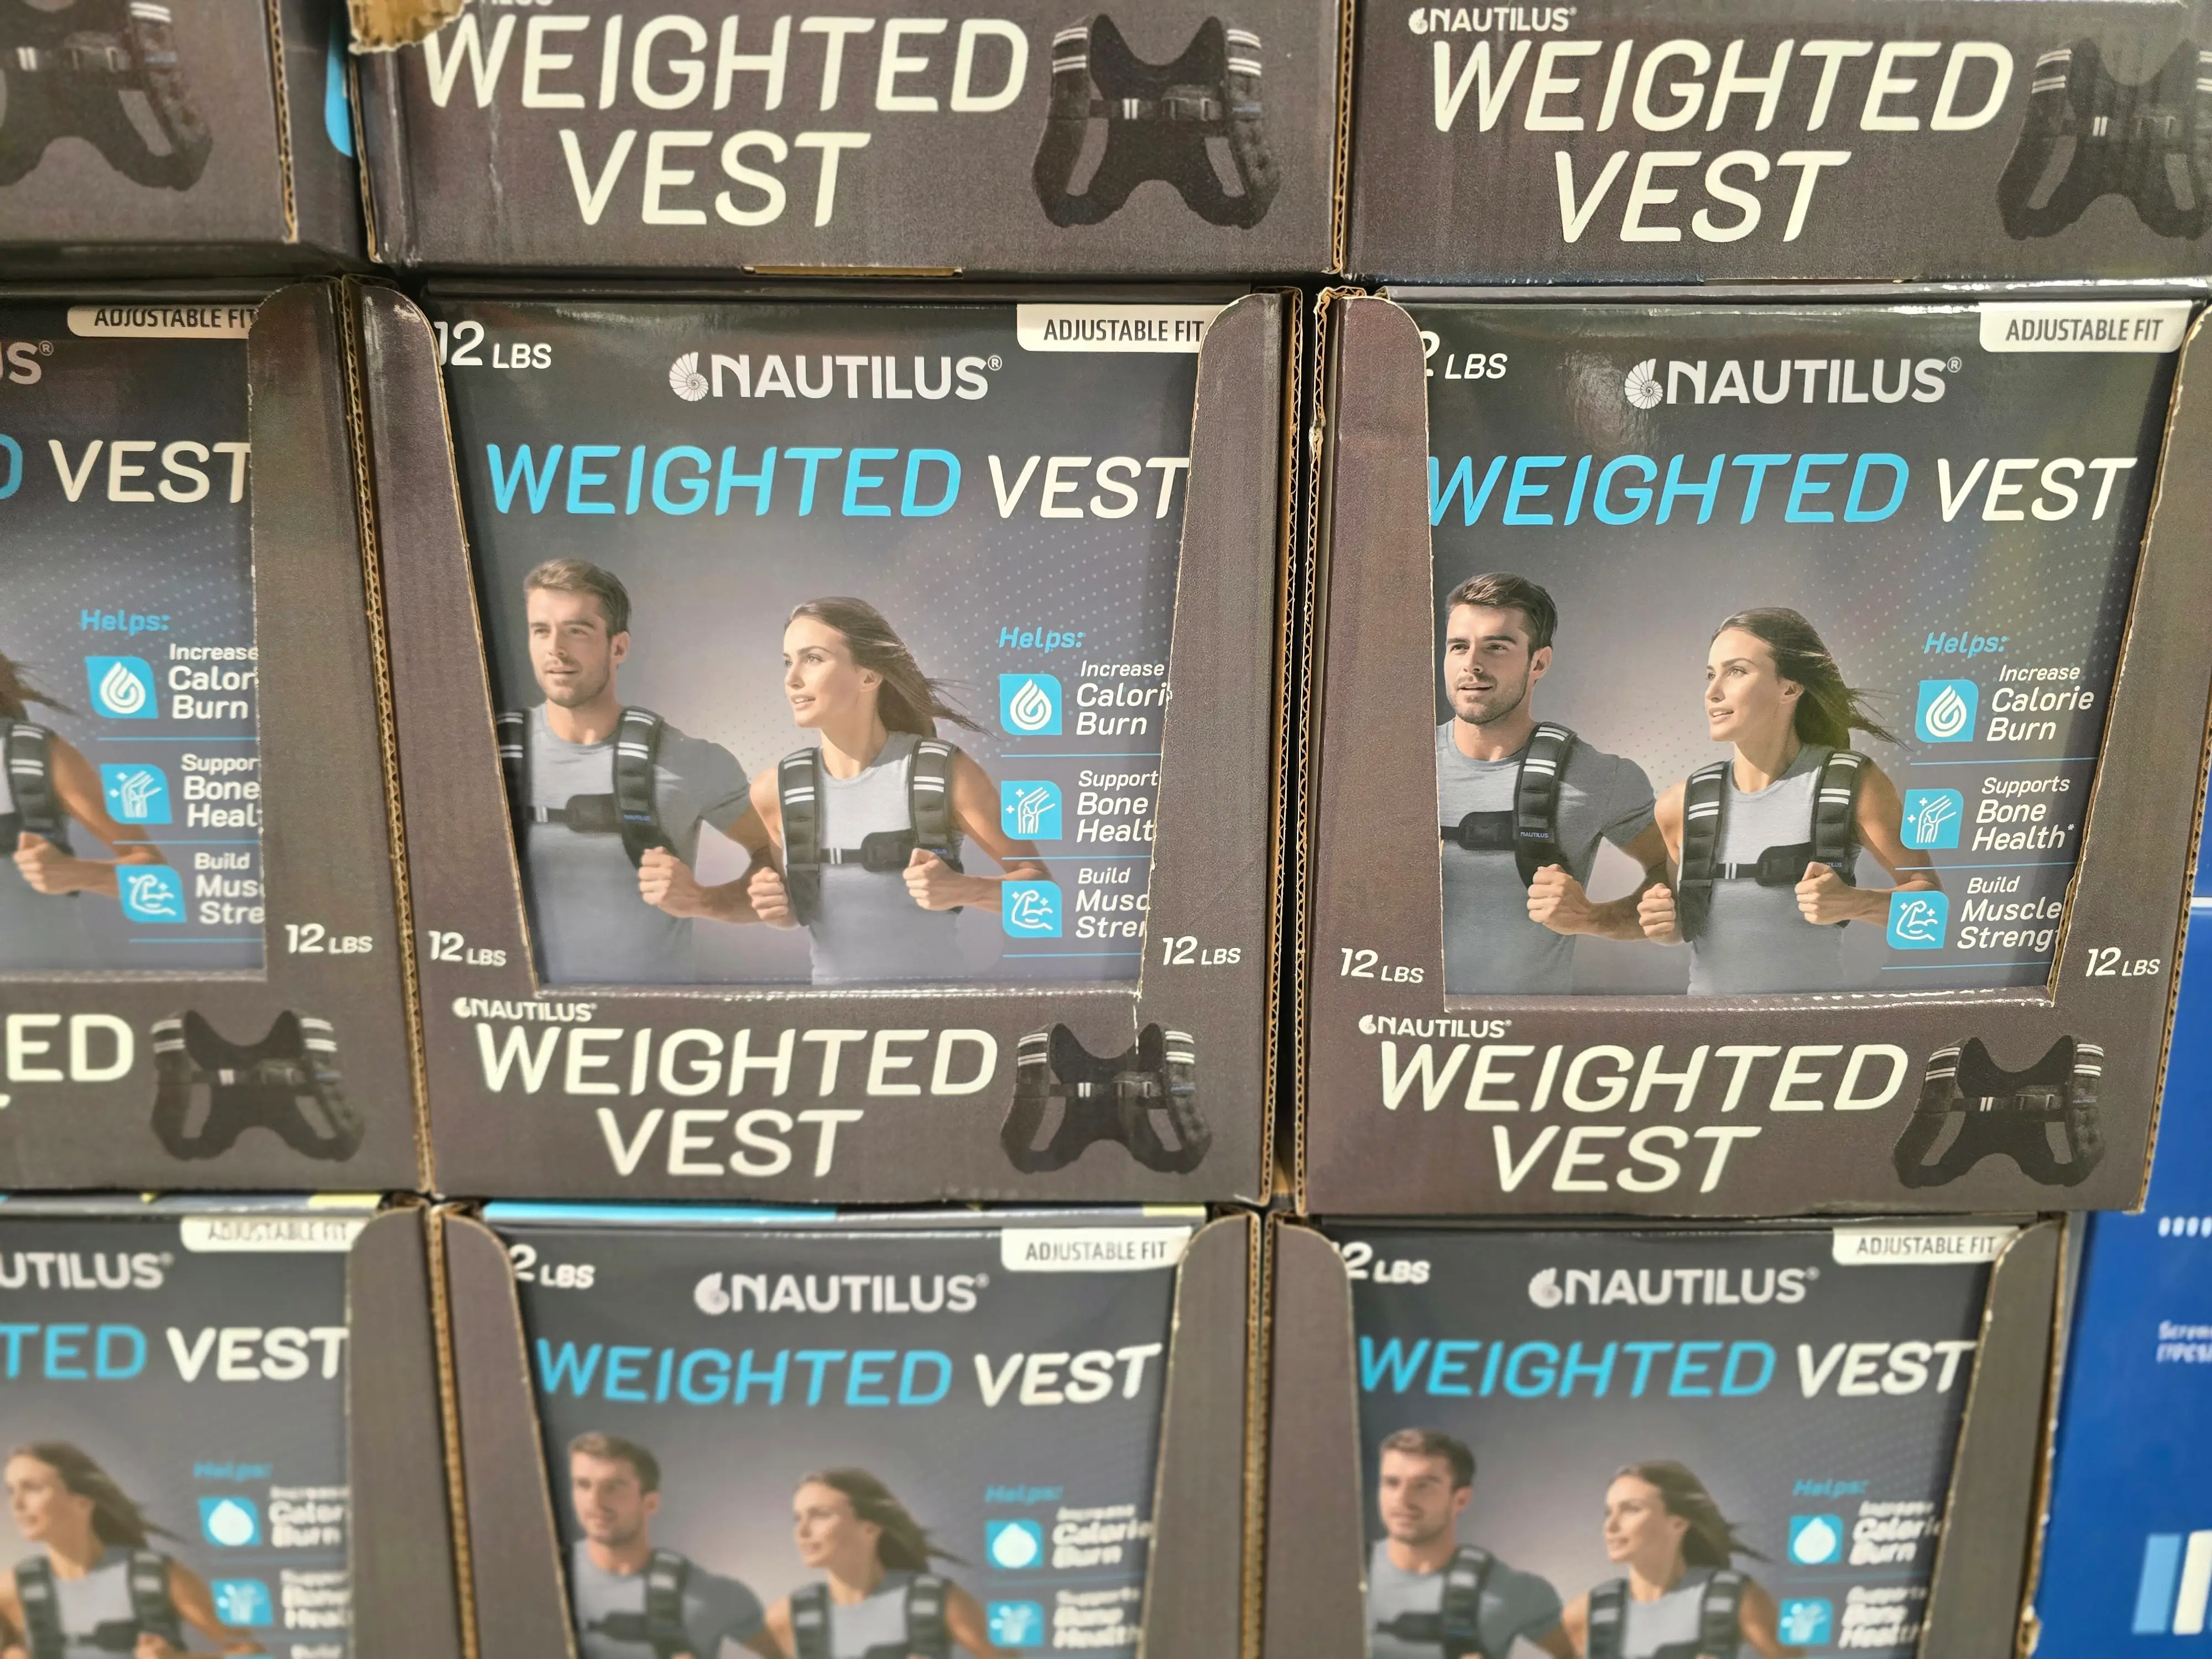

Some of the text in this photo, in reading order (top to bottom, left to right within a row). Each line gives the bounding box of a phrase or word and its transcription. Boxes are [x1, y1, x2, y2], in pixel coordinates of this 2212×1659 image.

[422, 13, 1029, 112] WEIGHTED
[1434, 39, 2014, 133] WEIGHTED
[559, 128, 872, 227] VEST
[1555, 150, 1852, 243] VEST
[94, 308, 258, 329] ADJUSTABLE FIT
[1044, 319, 1205, 342] ADJUSTABLE FIT
[2005, 319, 2164, 342] ADJUSTABLE FIT
[434, 321, 552, 369] 12 LBS
[1419, 331, 1508, 379] 2 LBS
[48, 440, 252, 503] VEST
[487, 444, 1191, 519] WEIGHTED VEST
[1428, 453, 2138, 526] WEIGHTED VEST
[80, 609, 170, 637] Helps:
[169, 643, 259, 661] Increase
[999, 627, 1084, 653] Helps:
[1923, 631, 2009, 658] Helps:
[168, 665, 258, 691] Calor
[1080, 660, 1165, 677] Increase
[1999, 664, 2080, 683] Increase
[172, 695, 249, 719] Burn
[1076, 682, 1167, 707] Calori
[1991, 685, 2095, 712] Calorie
[1076, 712, 1147, 735] Burn
[1986, 717, 2057, 742] Burn
[180, 753, 262, 776] Suppor
[184, 775, 261, 800] Bone
[1078, 770, 1159, 791] Support
[1981, 775, 2070, 798] Supports
[187, 803, 262, 828] Heal
[1077, 792, 1149, 815] Bone
[1976, 799, 2047, 824] Bone
[1076, 818, 1155, 843] Healt
[194, 852, 251, 870] Build
[195, 874, 265, 898] Mus
[1078, 867, 1130, 884] Build
[1966, 875, 2020, 894] Build
[199, 901, 265, 925] Stre
[1075, 889, 1149, 912] Musc
[1960, 896, 2062, 922] Muscle
[284, 923, 373, 954] 12 LBS
[1075, 915, 1145, 938] Stre
[1957, 926, 2058, 952] Streng
[429, 931, 506, 967] 12 LBS
[1162, 936, 1241, 966] 12 LBS
[2085, 947, 2161, 977] 12 LBS
[1339, 947, 1425, 984] 12 LBS
[477, 1024, 998, 1097] WEIGHTED
[1381, 1040, 1908, 1113] WEIGHTED
[597, 1107, 864, 1178] VEST
[1493, 1125, 1762, 1193] VEST
[1025, 1240, 1167, 1261] ADJUSTABLE FIT
[1857, 1236, 1997, 1256] ADJUSTABLE FIT
[0, 1251, 164, 1289] UTILUS
[509, 1244, 596, 1290] 2 LBS
[1332, 1241, 1431, 1285] 2 LBS
[166, 1327, 349, 1383] VEST
[1358, 1335, 1977, 1400] WEIGHTED VEST
[535, 1337, 1163, 1408] WEIGHTED VEST
